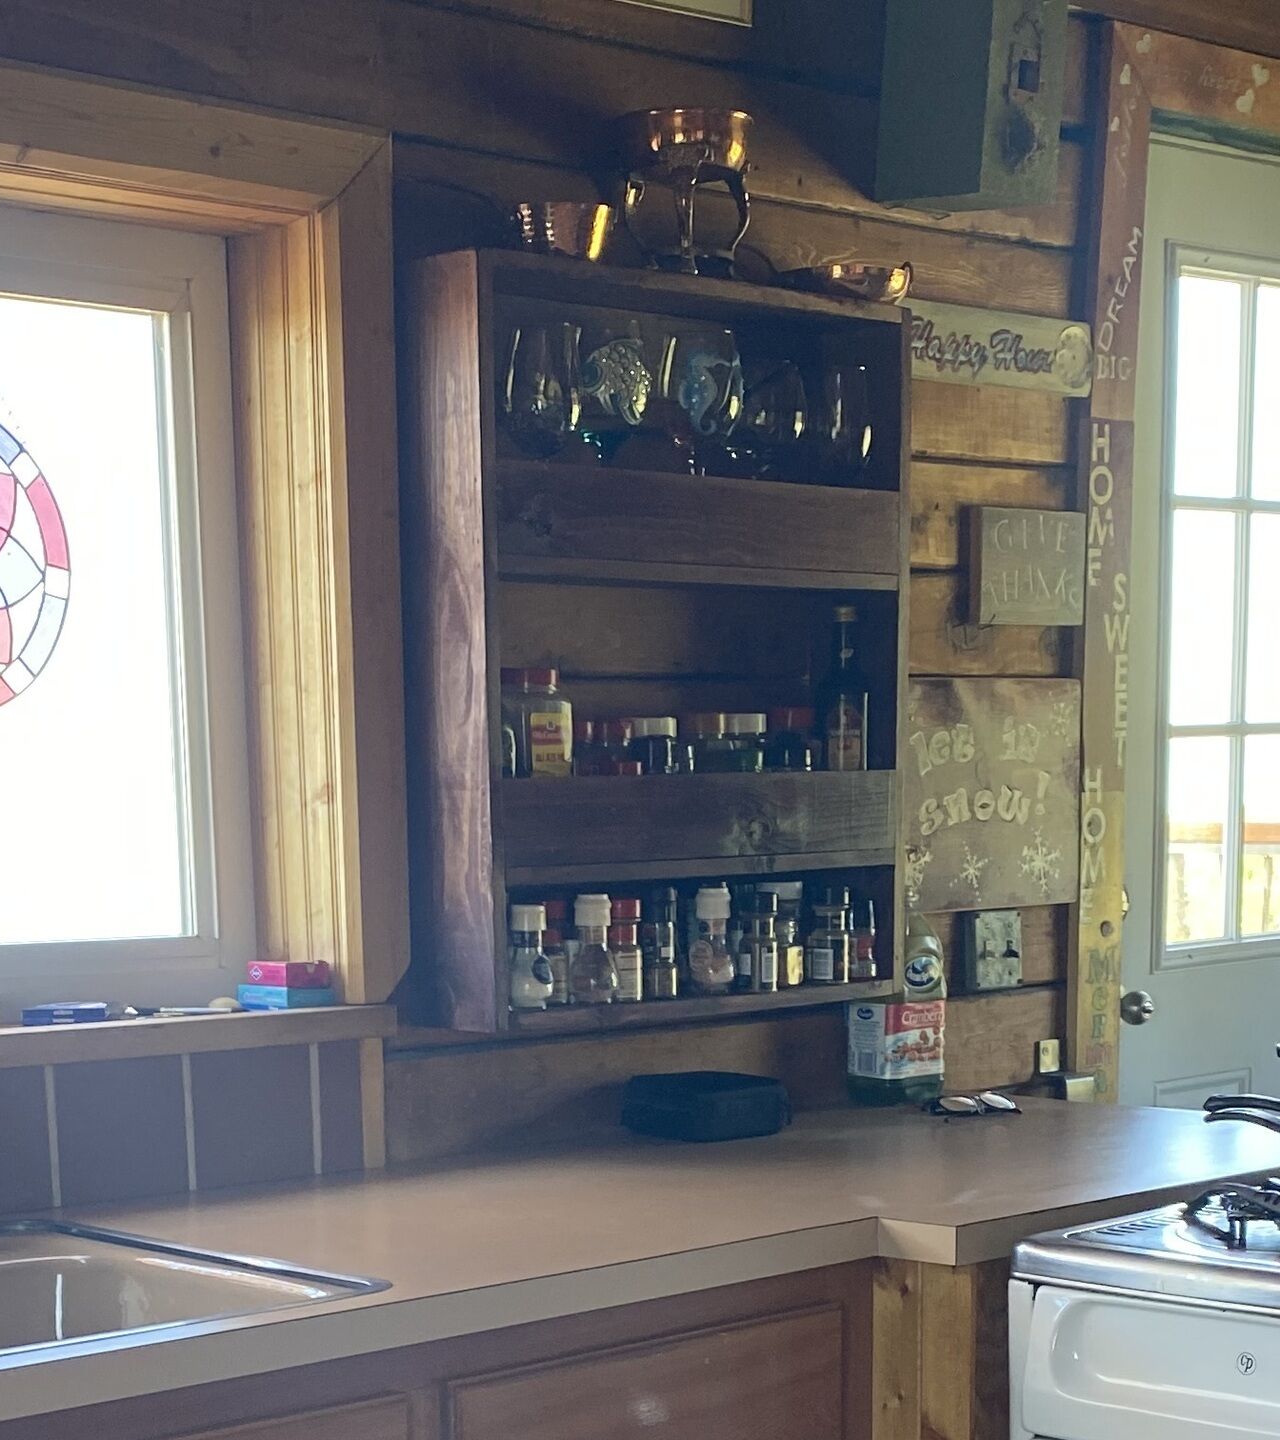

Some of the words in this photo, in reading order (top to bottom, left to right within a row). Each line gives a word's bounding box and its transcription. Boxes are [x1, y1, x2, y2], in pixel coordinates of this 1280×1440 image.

[911, 315, 989, 383] Happy
[990, 328, 1057, 375] Hour
[1097, 225, 1143, 352] DREAM
[1096, 354, 1132, 381] BIG
[1086, 423, 1115, 587] HOME
[1104, 573, 1131, 767] SWEET
[919, 770, 1052, 837] snow!
[1078, 768, 1107, 926] HOME
